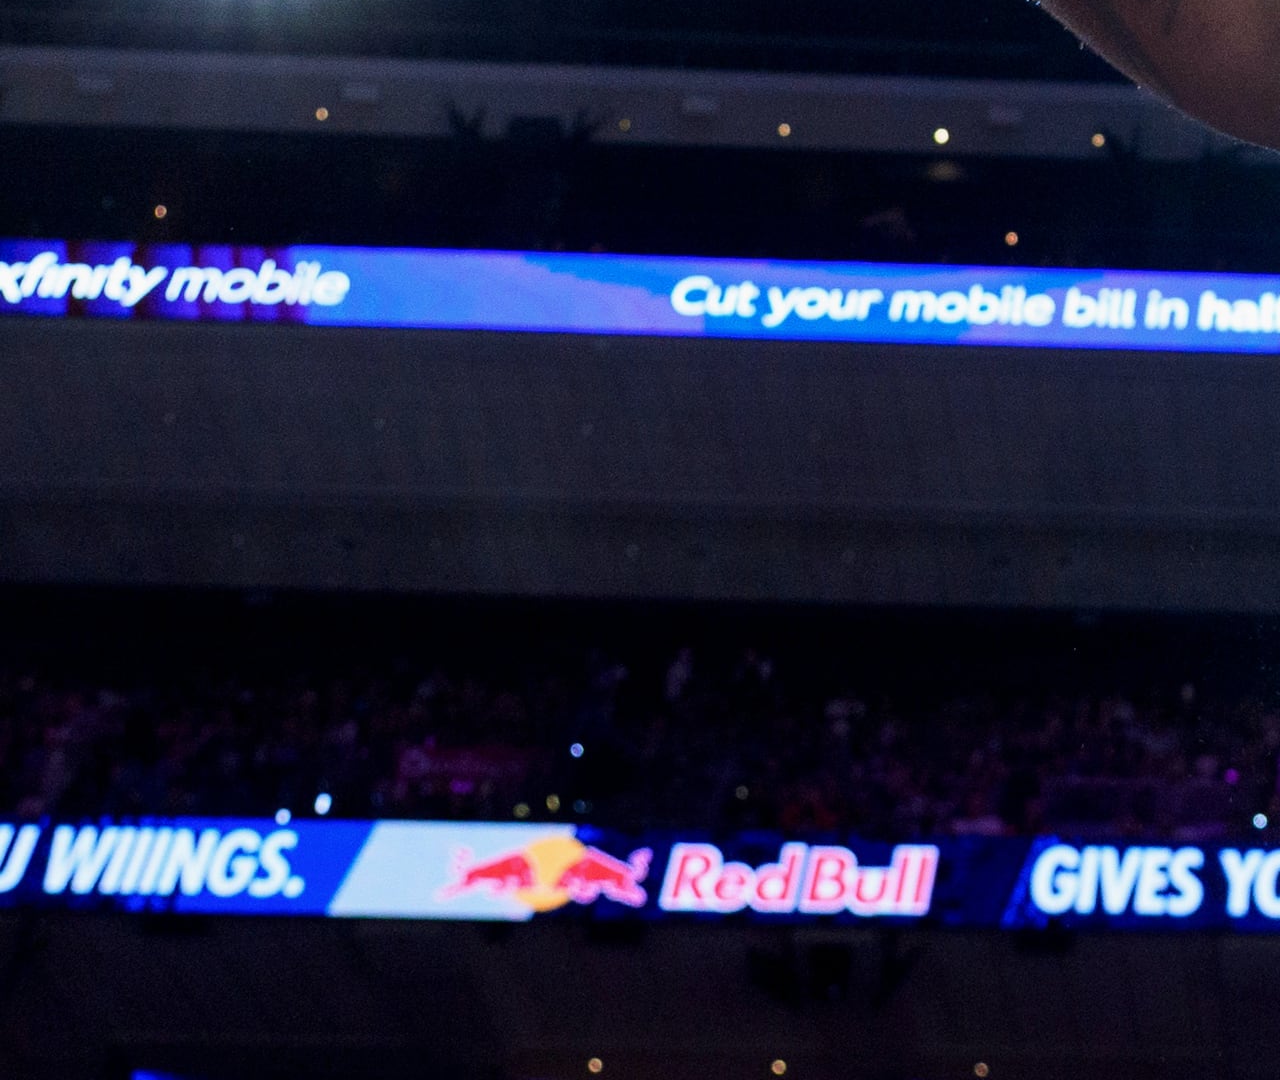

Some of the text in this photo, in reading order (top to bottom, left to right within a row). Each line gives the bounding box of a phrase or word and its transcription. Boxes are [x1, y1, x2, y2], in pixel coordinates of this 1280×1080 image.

[165, 258, 350, 306] mobile
[671, 275, 760, 318] Cut
[761, 286, 884, 328] your
[889, 284, 1056, 327] mobile
[1062, 287, 1137, 329] bill
[1145, 289, 1190, 330] in
[664, 848, 934, 911] Red Bull
[1029, 845, 1203, 917] GIVES
